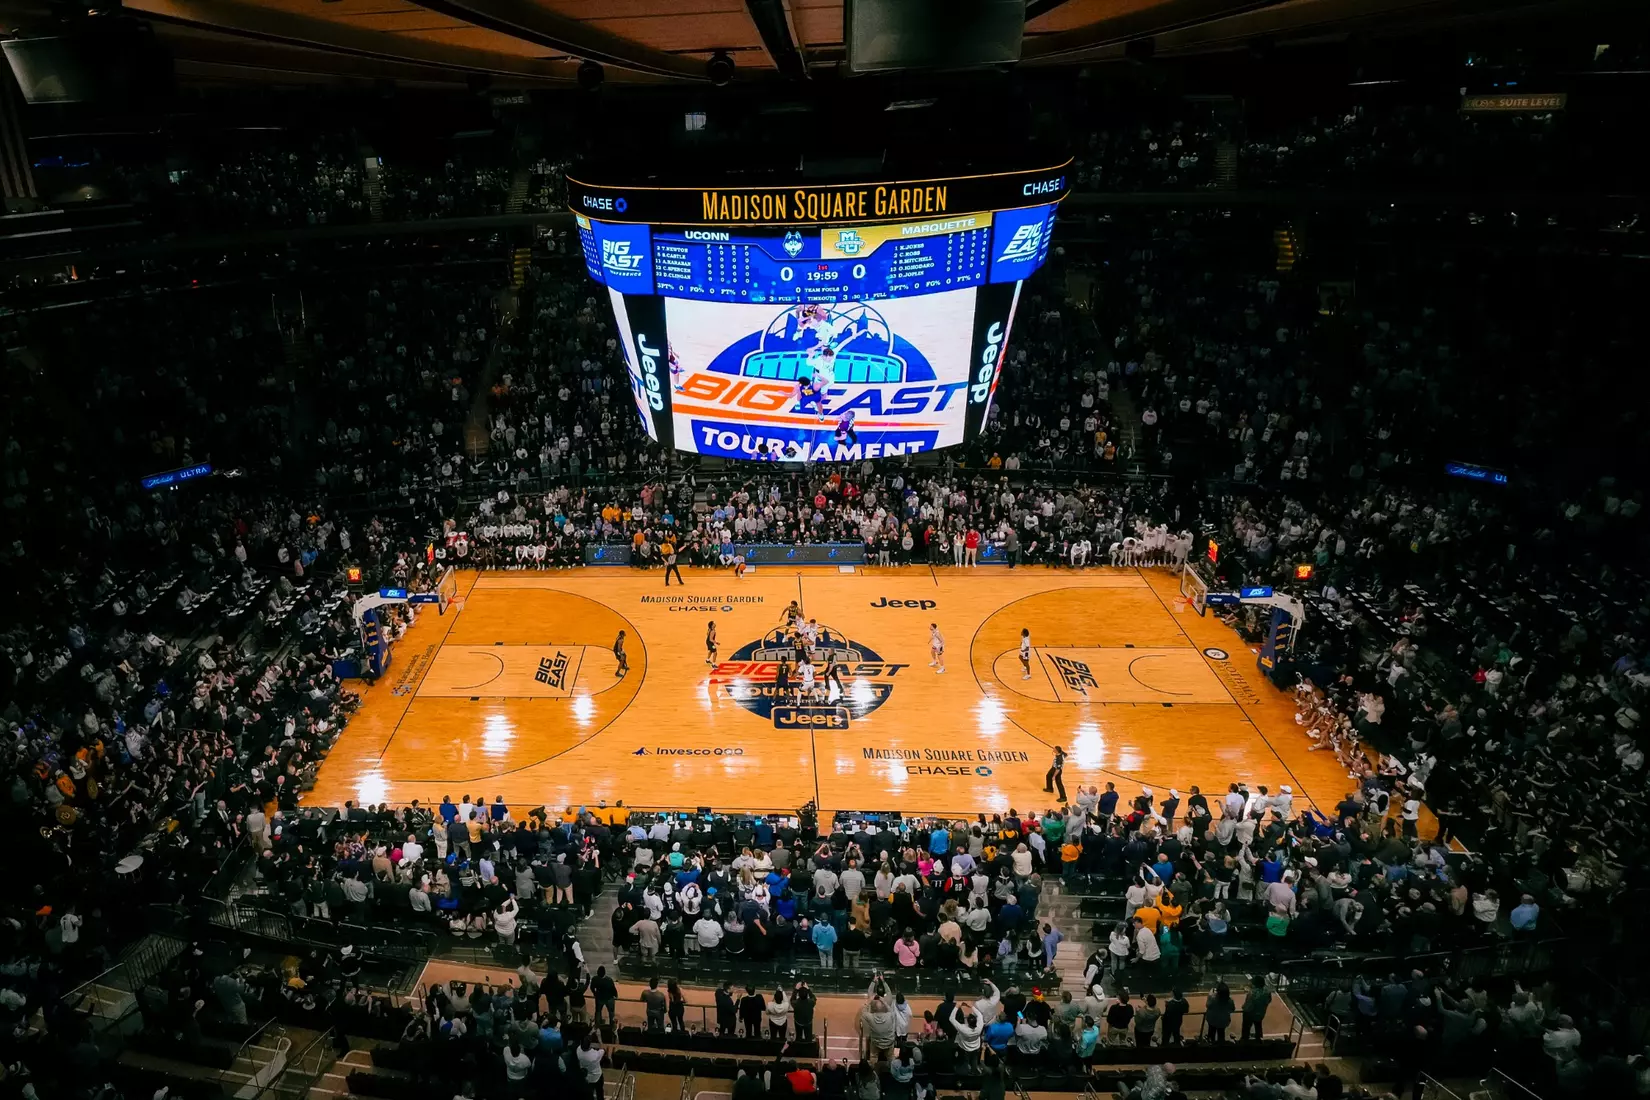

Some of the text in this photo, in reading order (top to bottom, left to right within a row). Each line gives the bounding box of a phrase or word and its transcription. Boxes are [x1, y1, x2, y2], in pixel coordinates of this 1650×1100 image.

[1499, 98, 1529, 107] SUITE
[1530, 98, 1561, 107] LEVEL
[1023, 178, 1060, 196] CHASE
[583, 195, 613, 210] CHASE
[703, 186, 947, 221] MADISON SQUARE GARDEN
[902, 218, 975, 234] MARQUETTE
[1012, 221, 1043, 240] BIG
[685, 231, 729, 240] UCONN
[602, 239, 631, 254] BIG
[603, 252, 644, 267] EAST
[780, 267, 794, 281] 0
[807, 272, 838, 280] 19:59
[853, 264, 866, 279] 0
[971, 321, 1003, 403] Jeep
[638, 333, 664, 411] Jeep
[675, 373, 794, 411] BIG
[701, 426, 925, 462] TOURNAMENT
[180, 467, 207, 478] ULTRA
[641, 595, 764, 603] MADISON SQUARE GARDEN
[870, 597, 936, 610] Jeep
[535, 657, 554, 684] BIG
[547, 651, 567, 688] EAST
[709, 662, 781, 676] BIG
[1055, 656, 1087, 696] EAST
[780, 711, 842, 728] Jeep
[656, 747, 744, 756] Invesco QQQ
[863, 748, 1029, 762] MADISON SQUARE GARDEN
[906, 766, 972, 776] CHASE
